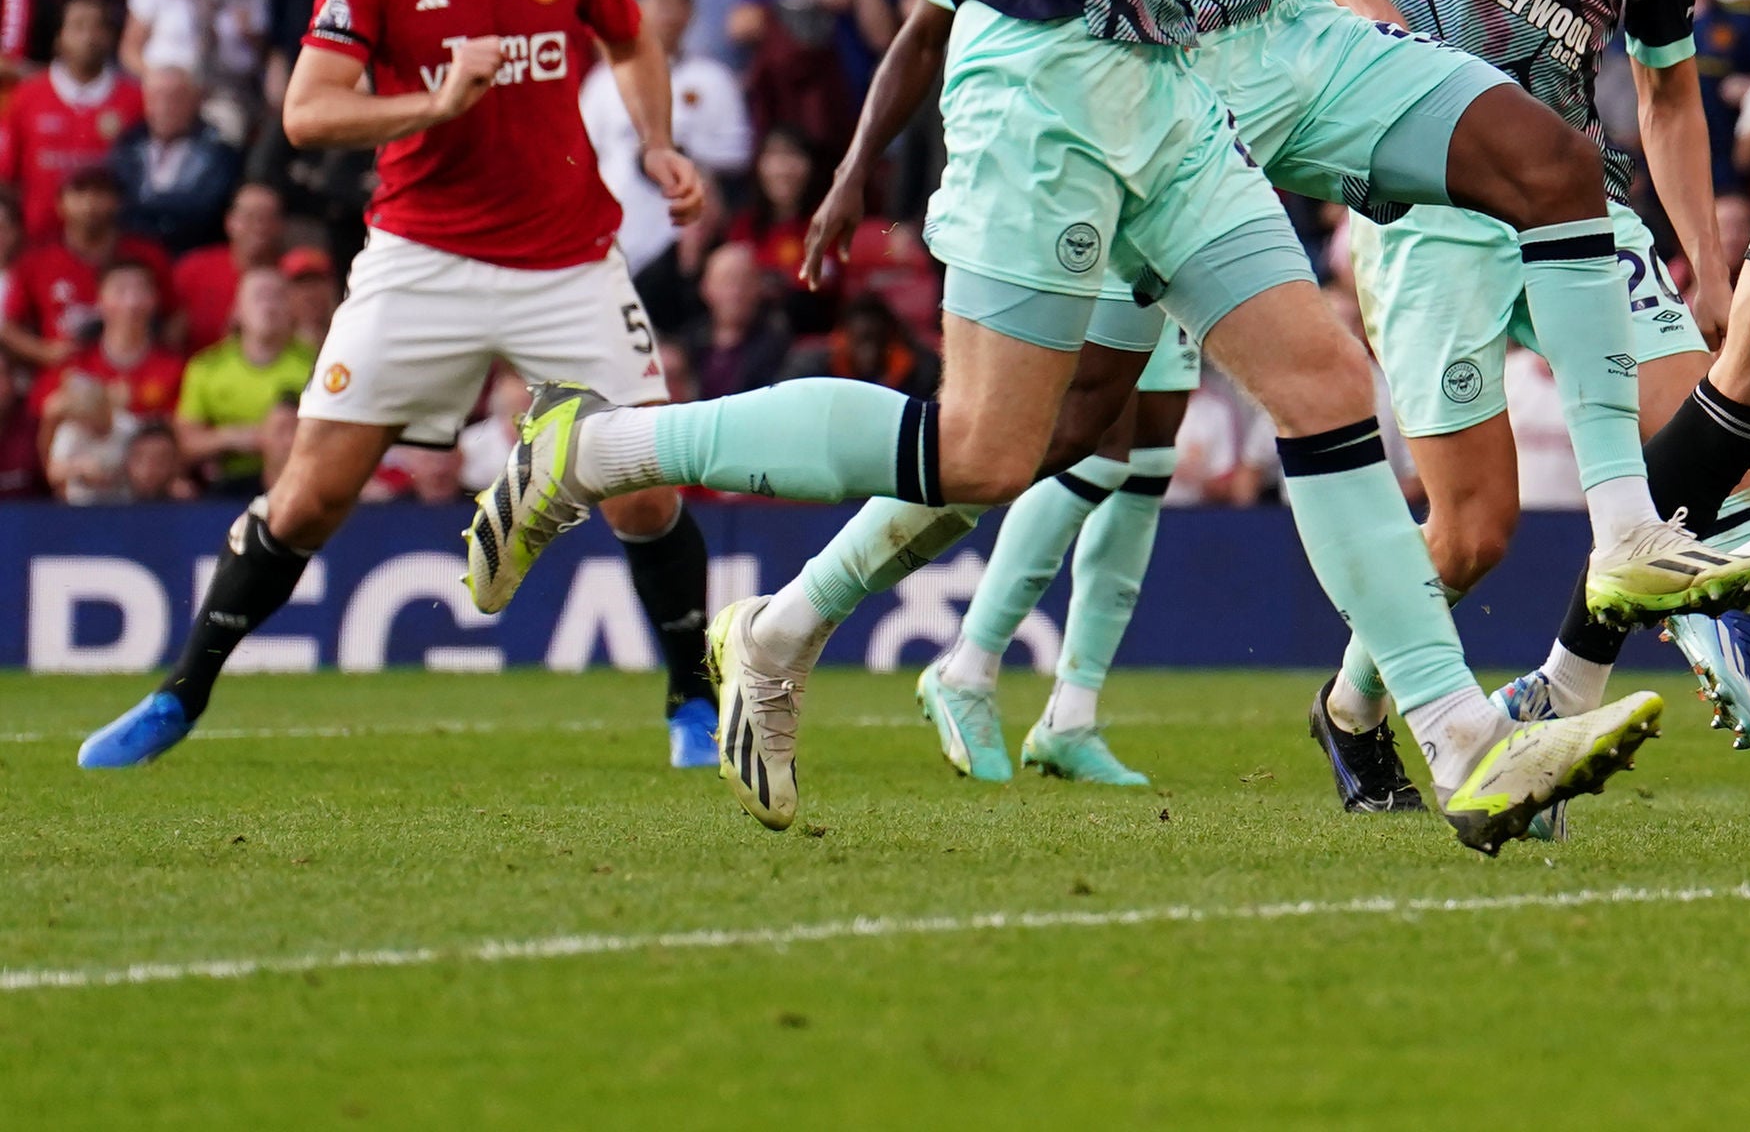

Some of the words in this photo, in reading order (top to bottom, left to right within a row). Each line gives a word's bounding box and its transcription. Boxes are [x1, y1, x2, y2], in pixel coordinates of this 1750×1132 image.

[441, 34, 529, 60] Tm
[1550, 39, 1582, 70] bets
[419, 59, 529, 93] Ver
[620, 303, 653, 354] 5
